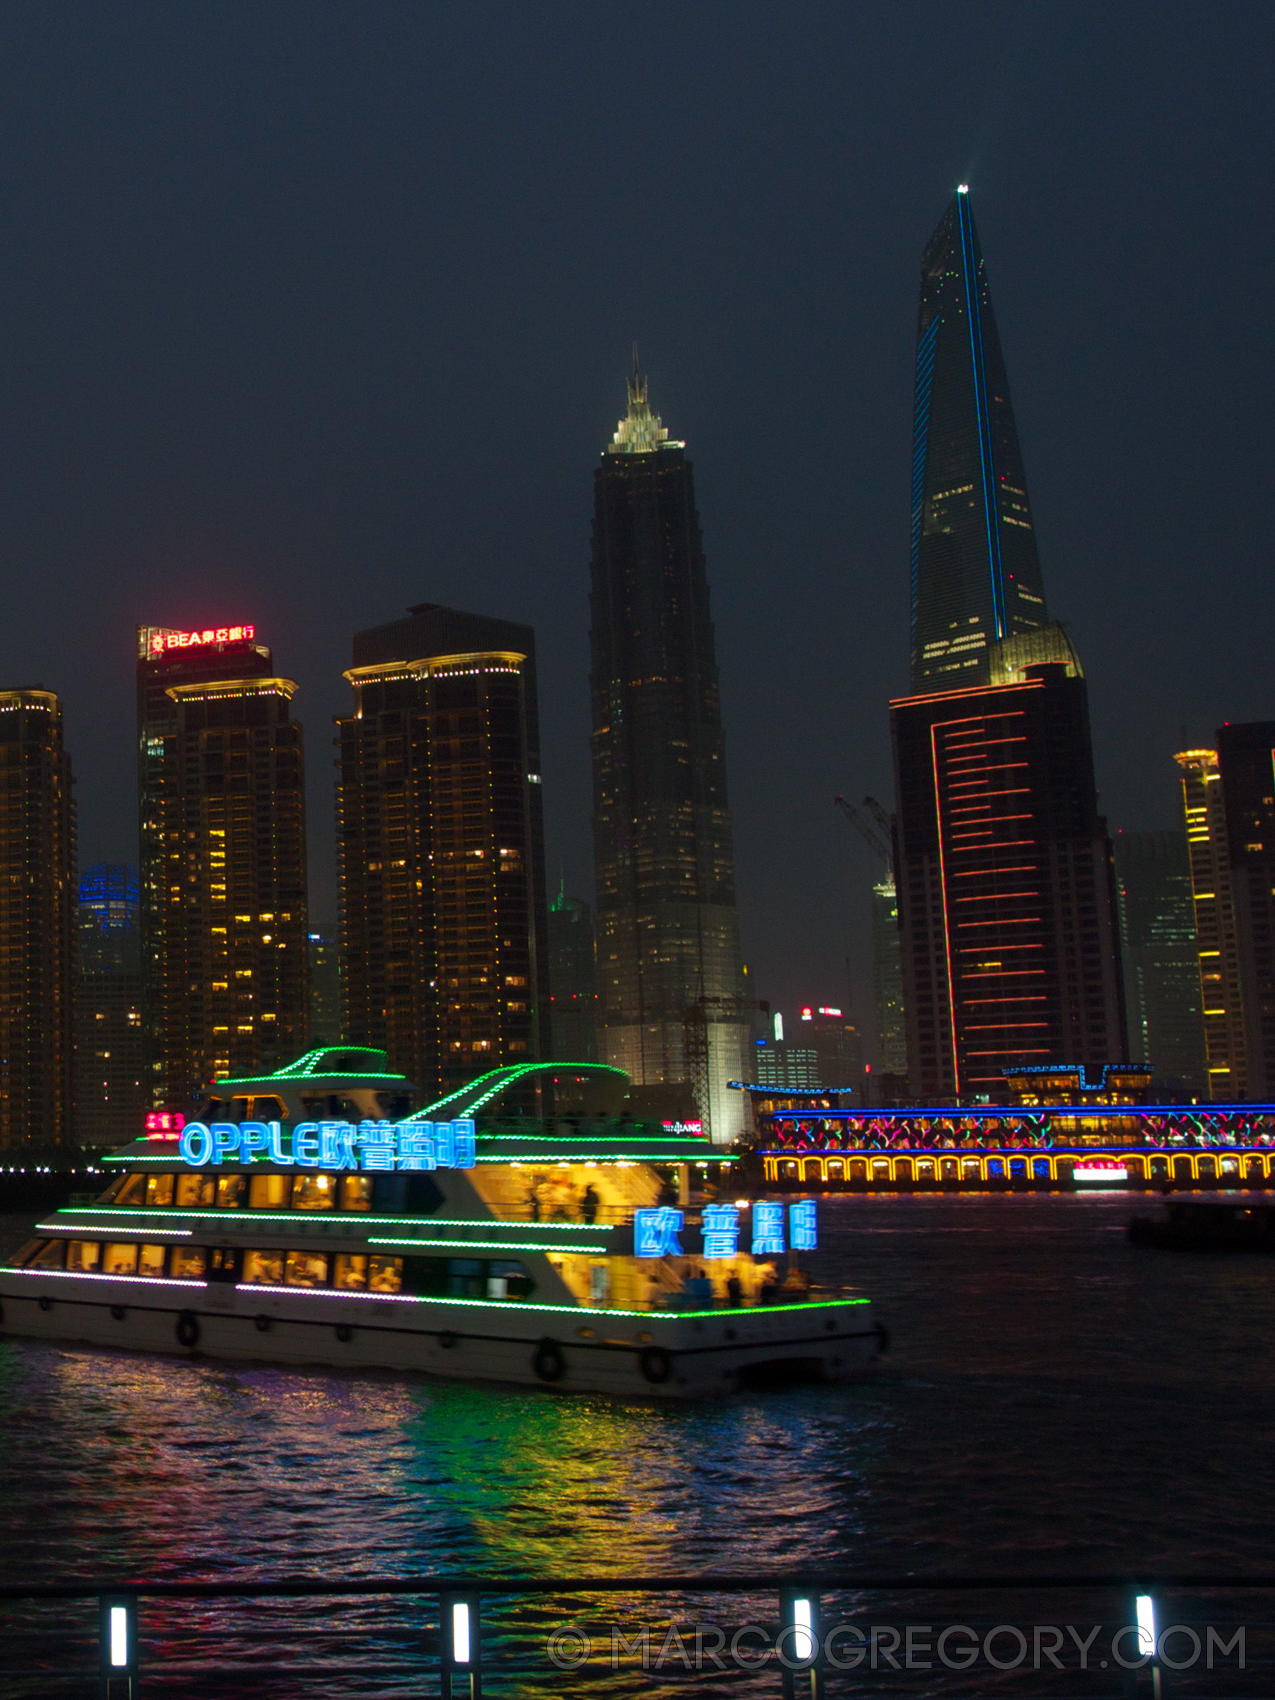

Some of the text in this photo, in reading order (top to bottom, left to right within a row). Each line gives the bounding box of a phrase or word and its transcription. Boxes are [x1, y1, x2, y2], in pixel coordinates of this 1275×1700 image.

[166, 632, 202, 649] BEA
[179, 1119, 475, 1170] OPPLE 欧普照明
